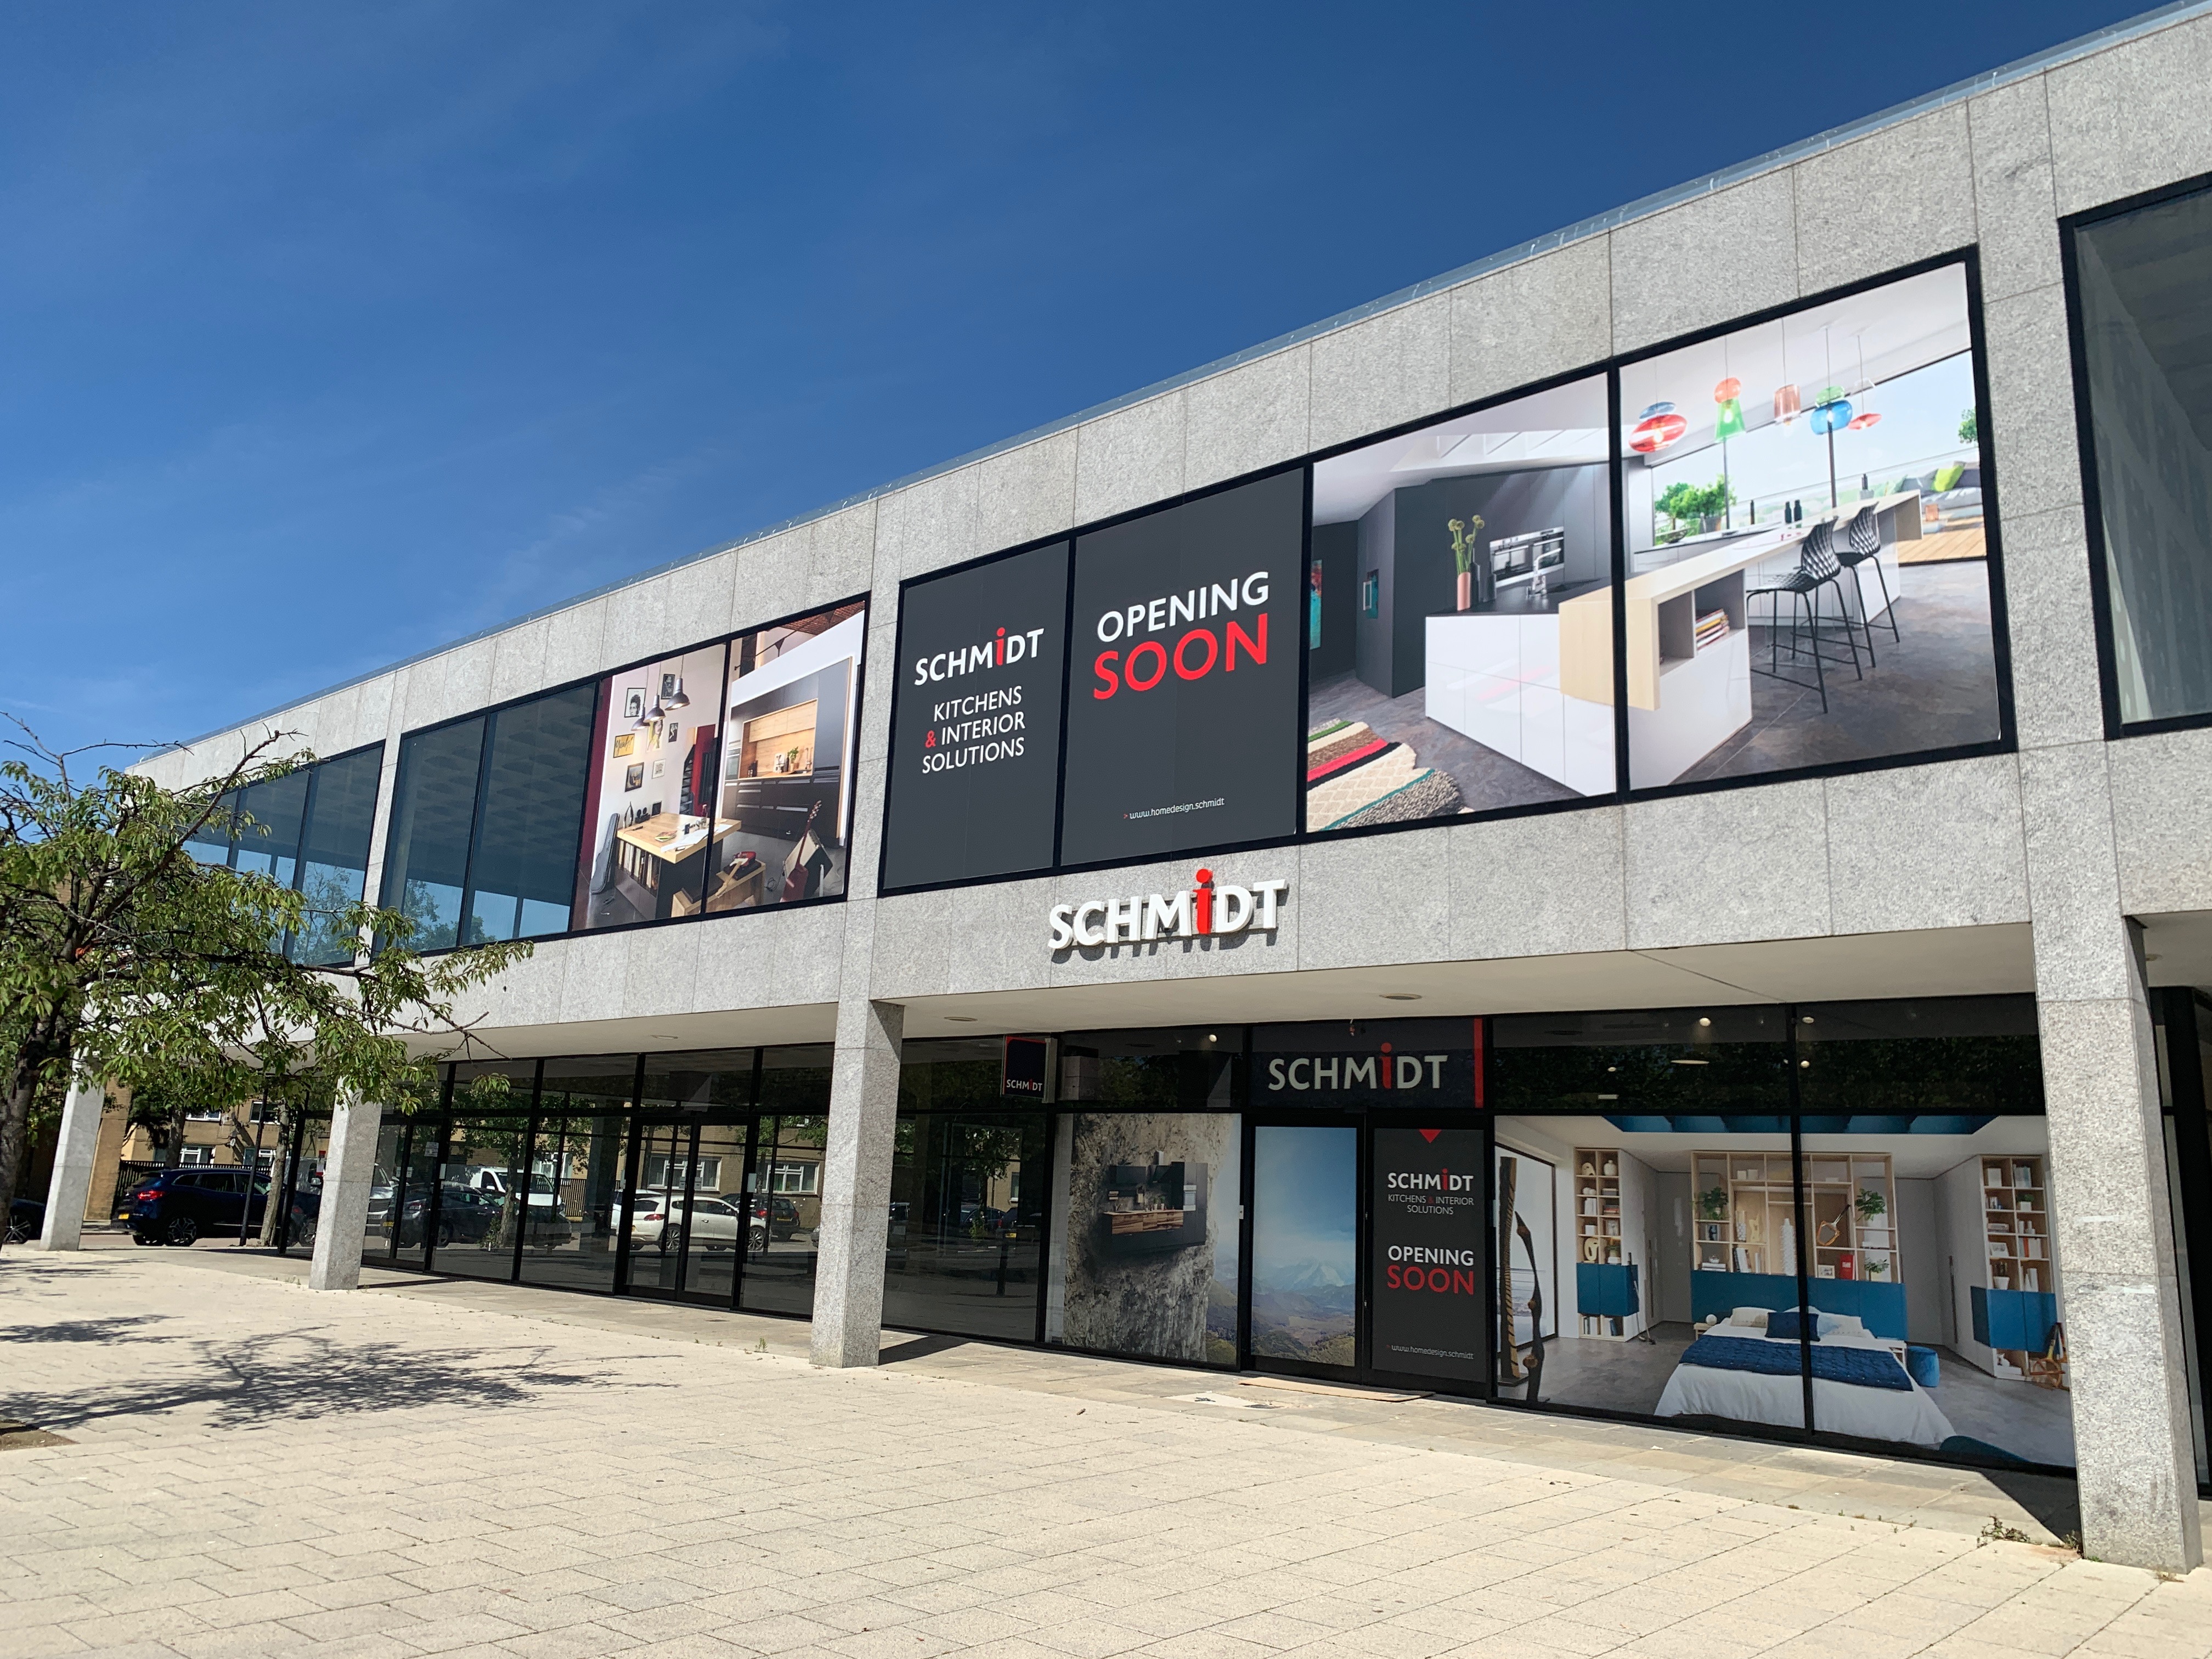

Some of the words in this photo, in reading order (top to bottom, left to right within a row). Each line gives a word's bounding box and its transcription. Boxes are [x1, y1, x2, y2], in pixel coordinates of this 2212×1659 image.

[1097, 572, 1269, 642] OPENING
[1093, 613, 1268, 699] SOON
[934, 686, 1022, 721] KITCHENS
[925, 730, 935, 748] &
[941, 712, 1025, 747] INTERIOR
[922, 737, 1025, 774] SOLUTIONS
[1130, 798, 1225, 819] www.homedesign.schmidt
[1388, 1194, 1426, 1204] KITCHENS
[1436, 1197, 1474, 1205] INTERIOR
[1407, 1205, 1454, 1215] SOLUTIONS
[1388, 1246, 1474, 1266] OPENING
[1387, 1265, 1474, 1295] SOON
[1391, 1345, 1474, 1359] www.homedesign.schmidt
